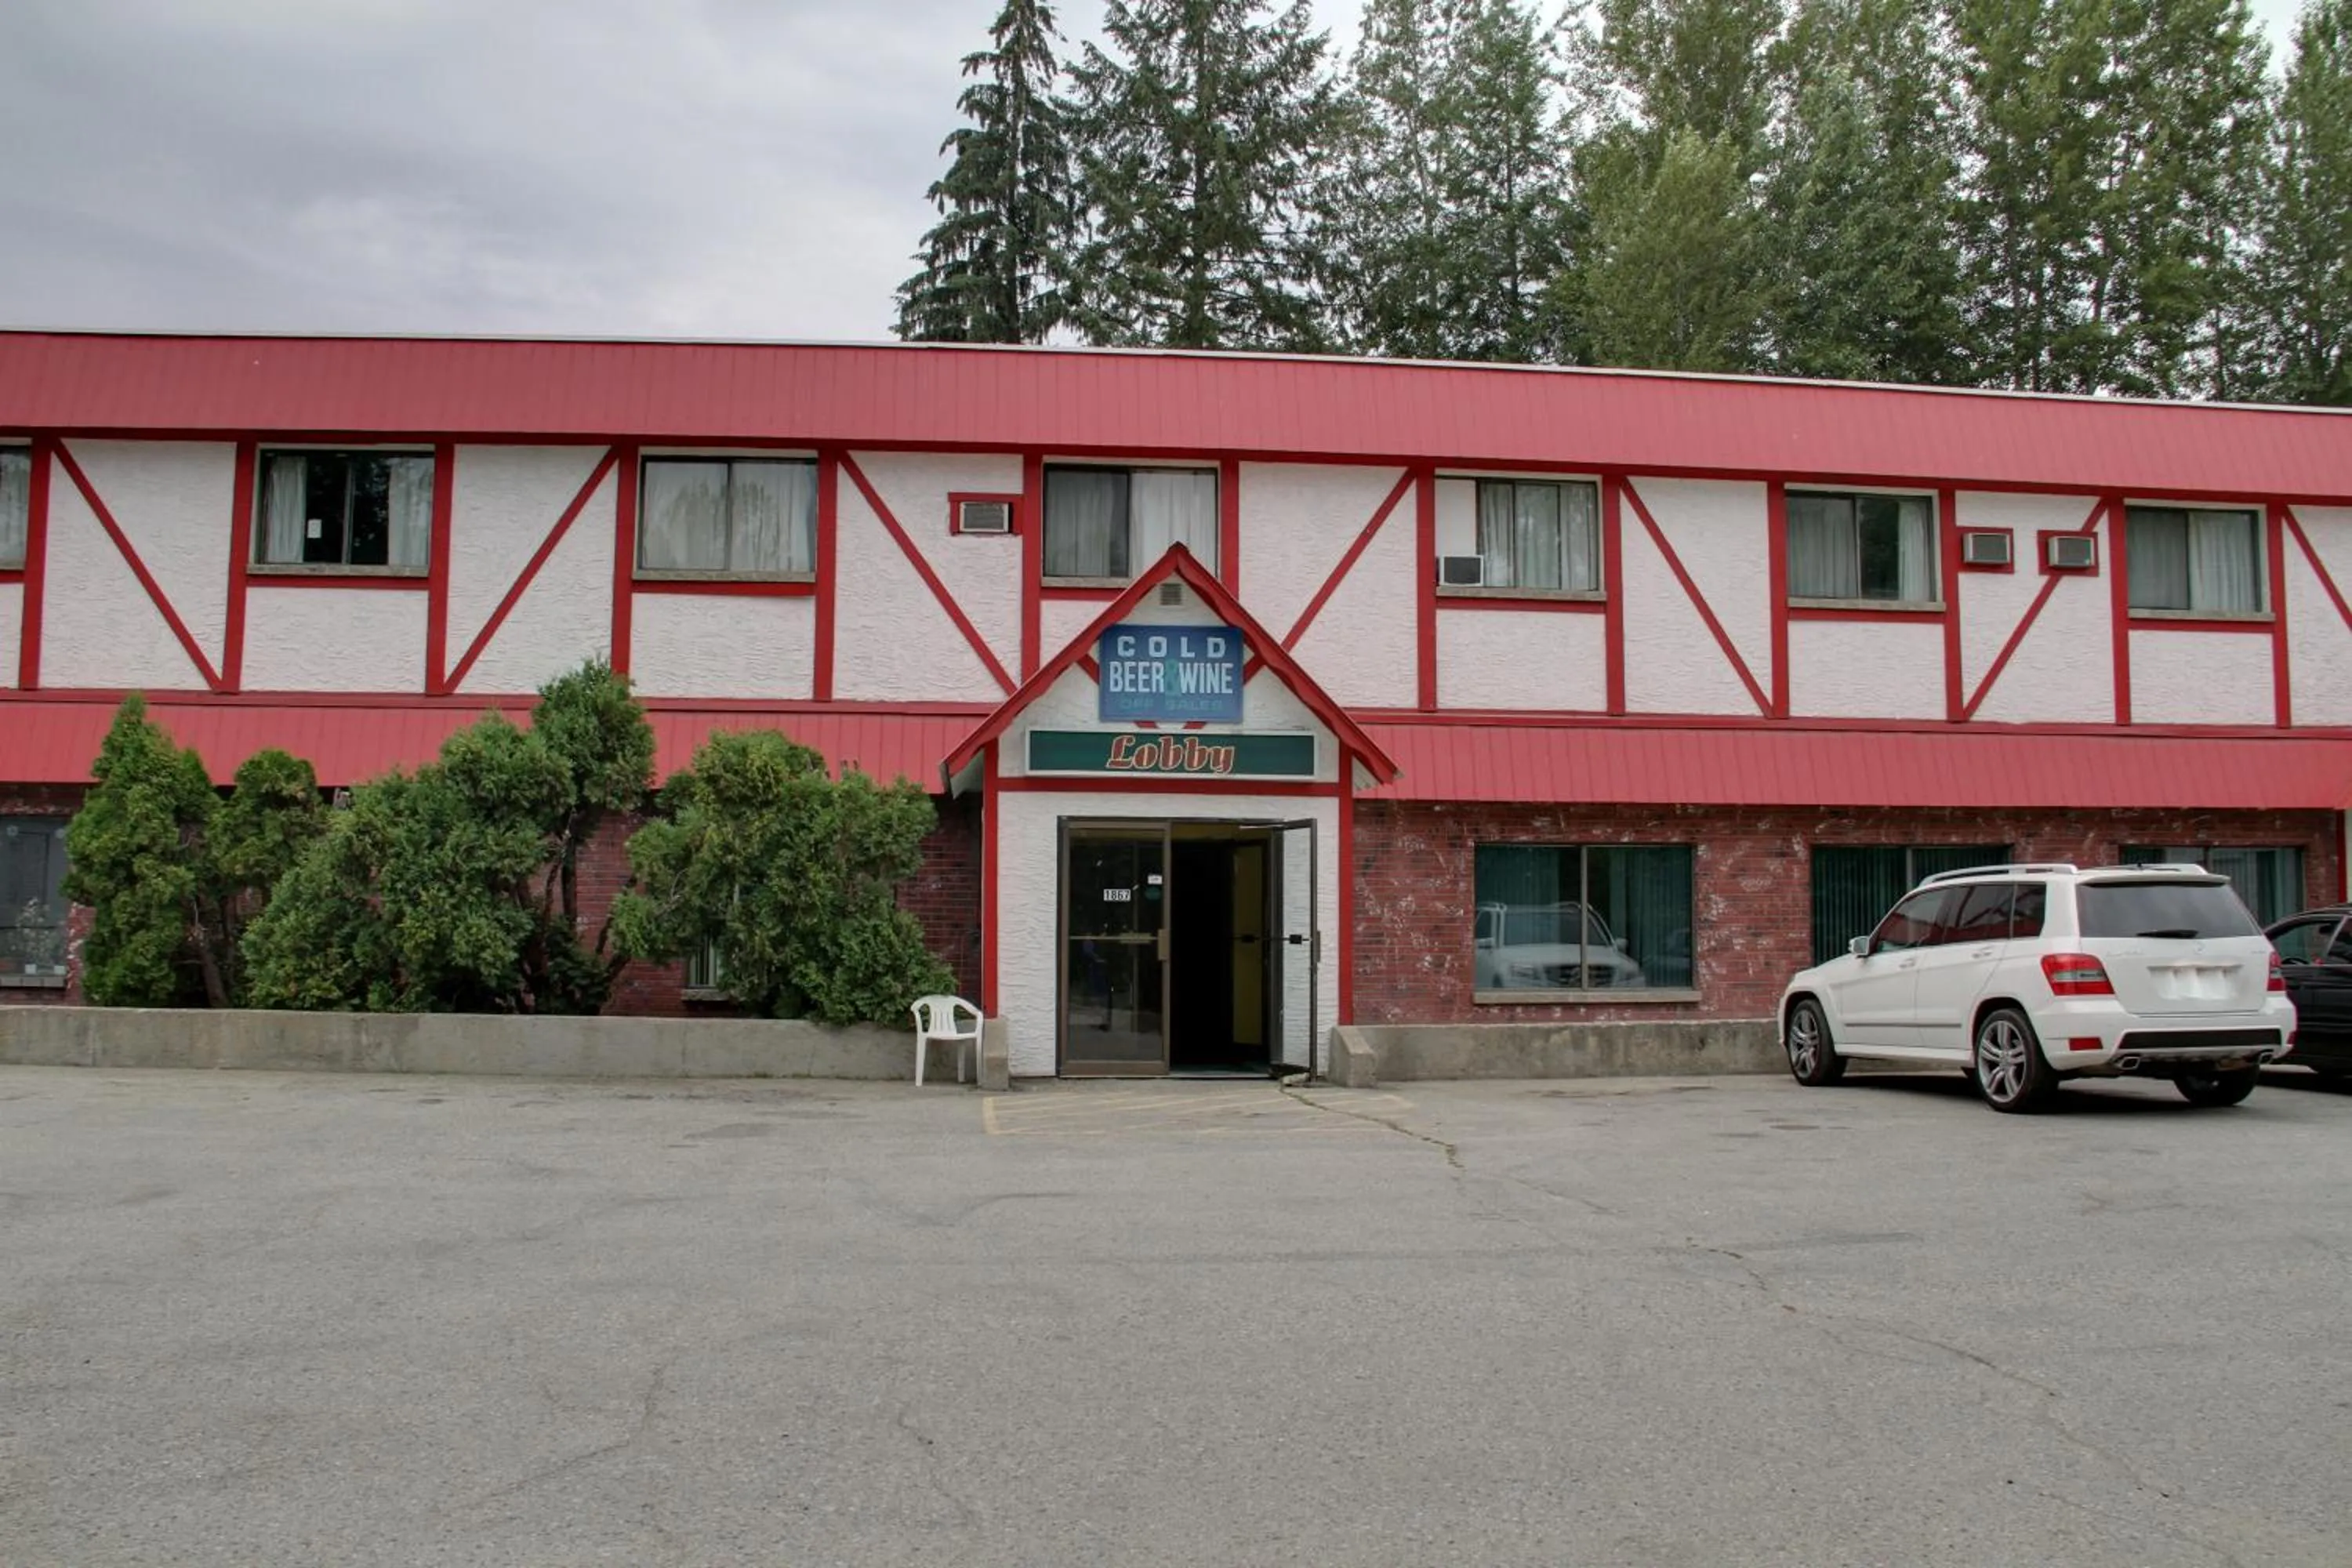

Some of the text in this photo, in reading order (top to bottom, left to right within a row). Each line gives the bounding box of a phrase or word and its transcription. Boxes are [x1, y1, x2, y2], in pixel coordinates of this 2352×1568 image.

[1117, 636, 1226, 658] COLD
[1109, 661, 1164, 693] BEER
[1178, 662, 1234, 694] WINE
[1105, 735, 1235, 774] Lobby
